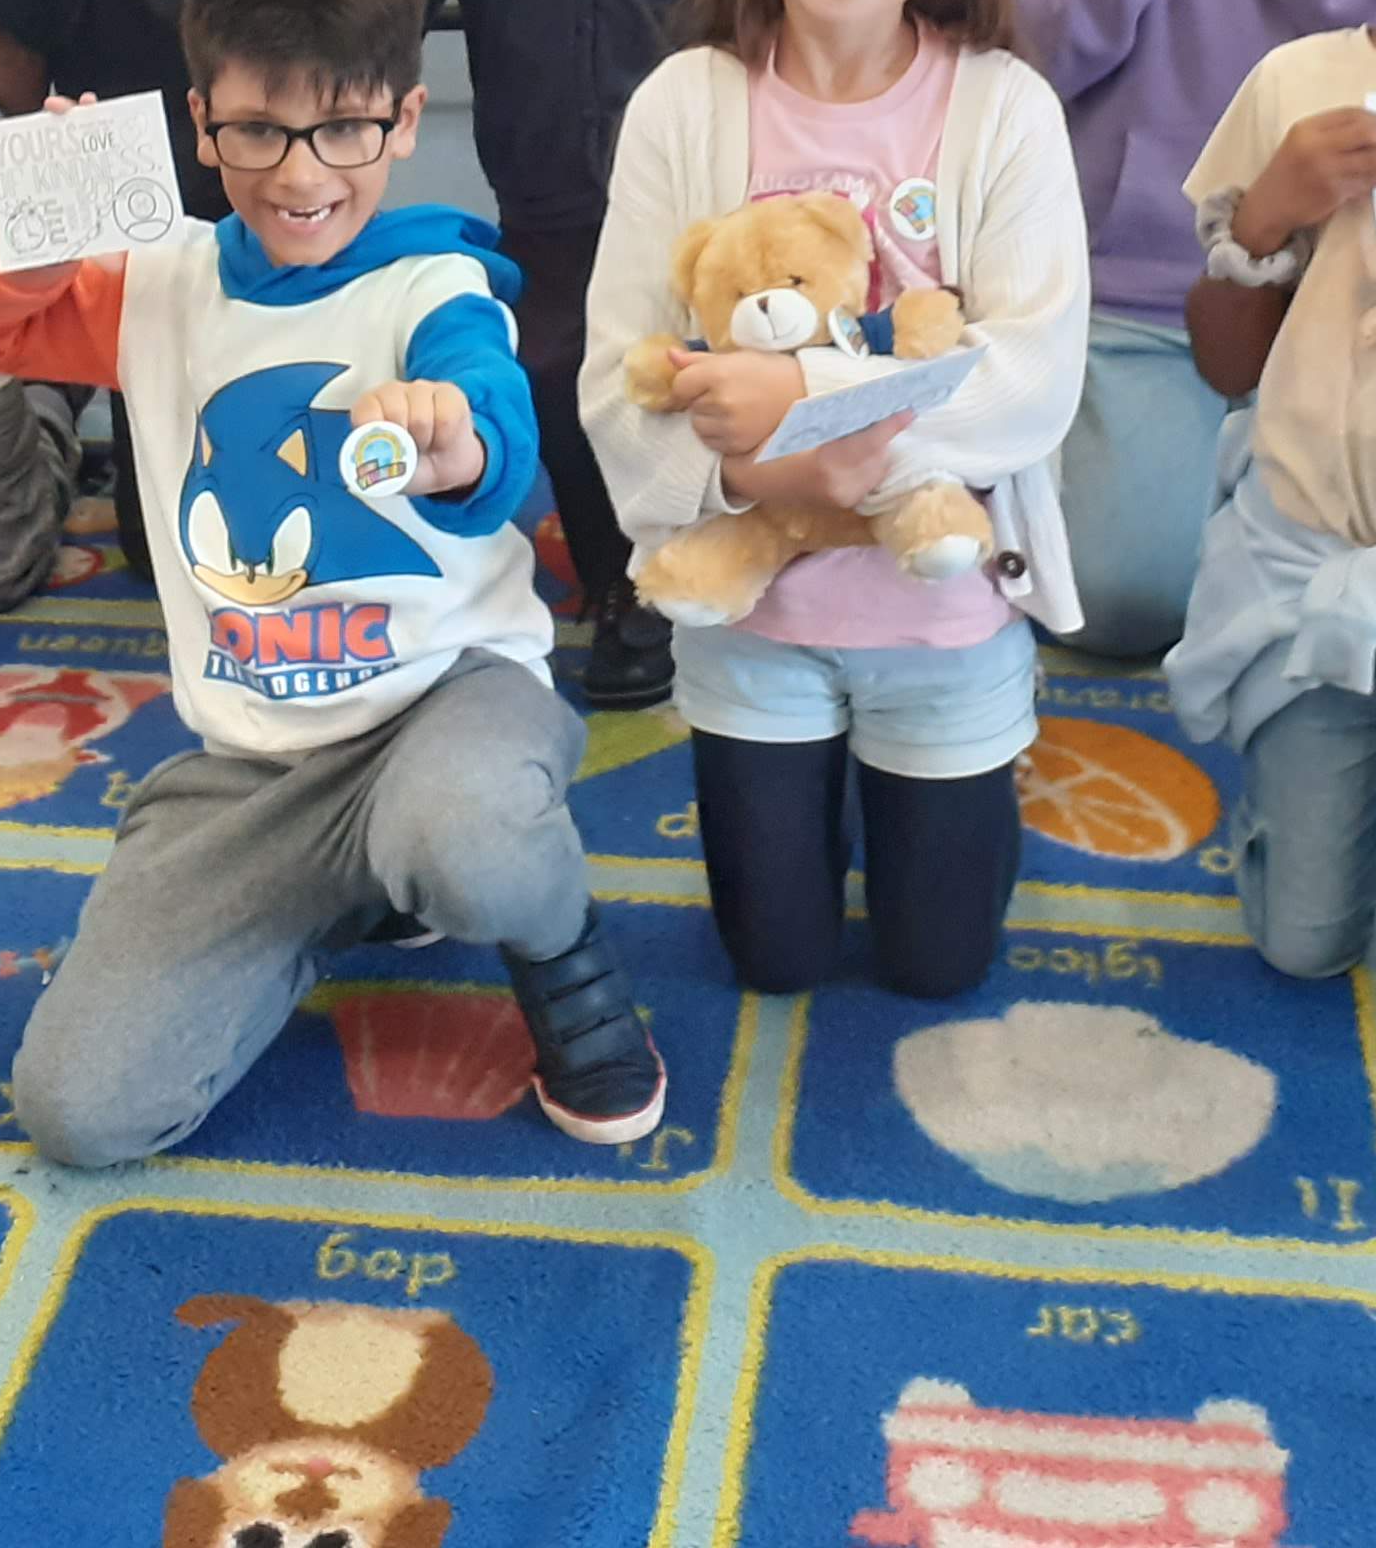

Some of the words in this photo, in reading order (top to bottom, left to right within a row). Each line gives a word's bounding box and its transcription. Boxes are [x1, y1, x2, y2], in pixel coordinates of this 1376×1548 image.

[82, 131, 115, 153] LOVE
[210, 602, 396, 669] ONIC
[1008, 941, 1166, 986] igloo
[314, 1231, 457, 1296] dog
[1026, 1304, 1141, 1345] car
